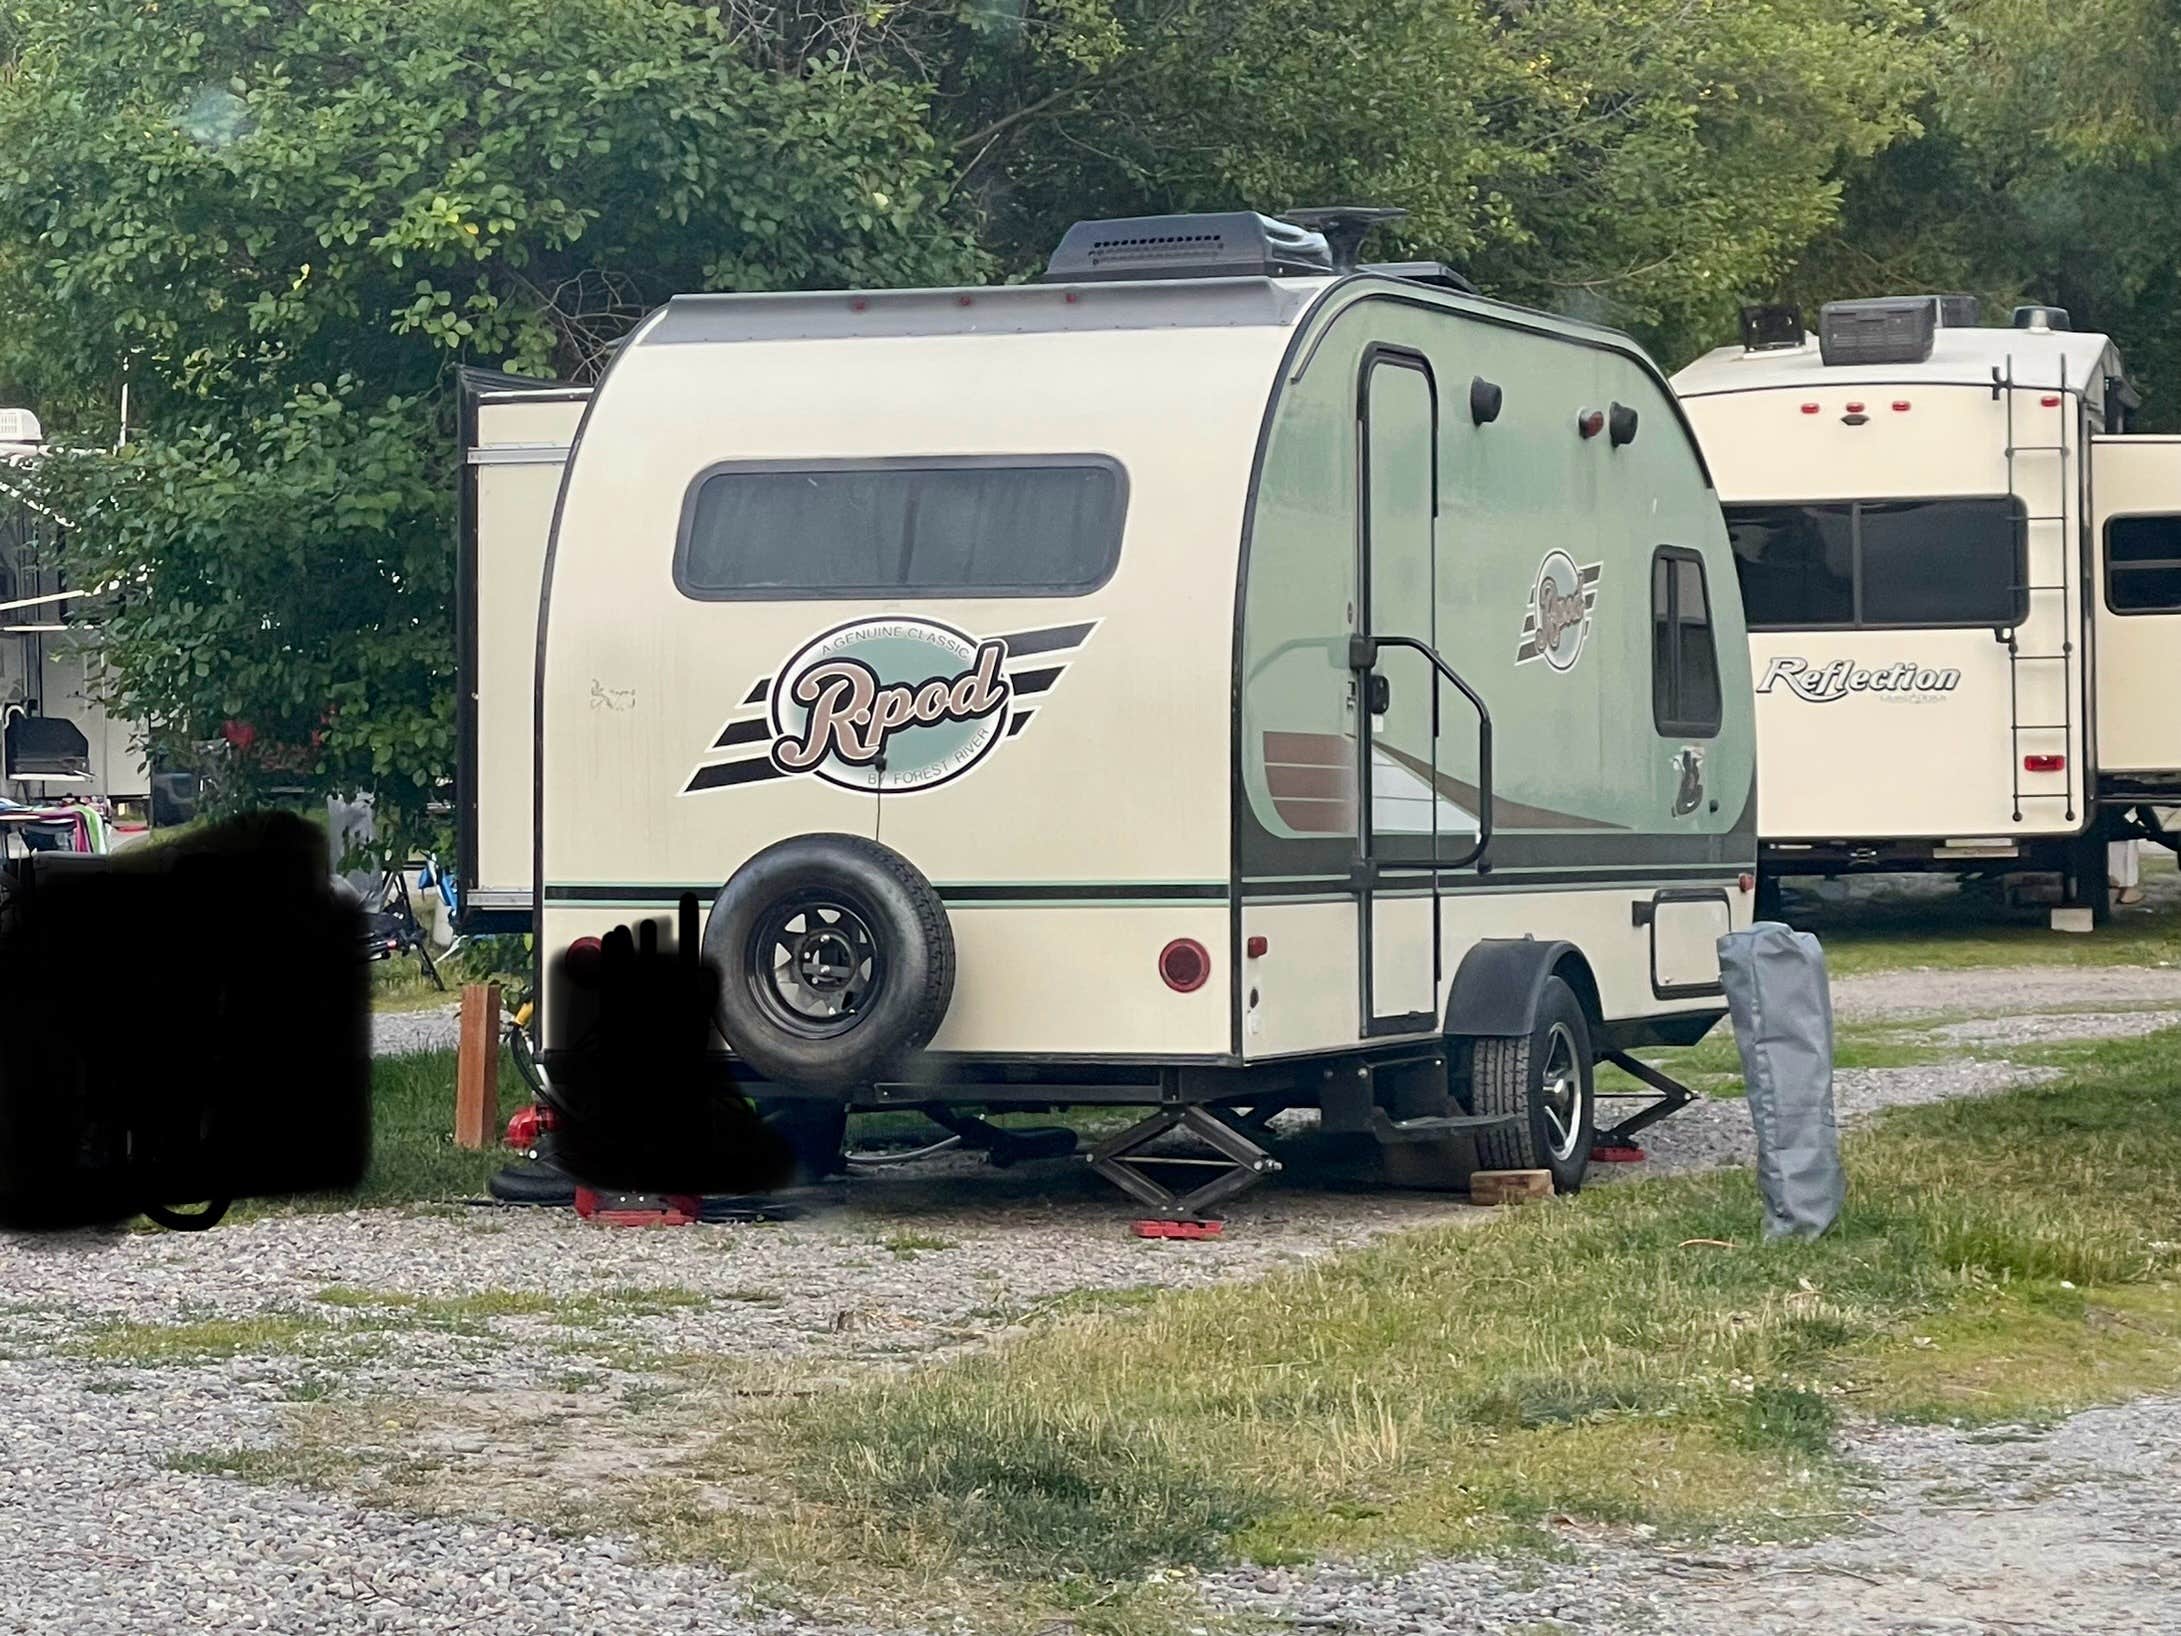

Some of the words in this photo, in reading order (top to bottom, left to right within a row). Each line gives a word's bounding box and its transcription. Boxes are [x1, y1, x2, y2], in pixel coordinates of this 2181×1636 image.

[822, 645, 832, 657] A
[833, 626, 902, 649] GENUINE
[907, 628, 970, 659] CLASSIC
[1756, 657, 1960, 702] Reflection
[894, 760, 949, 785] FOREST
[954, 728, 989, 763] RIVER
